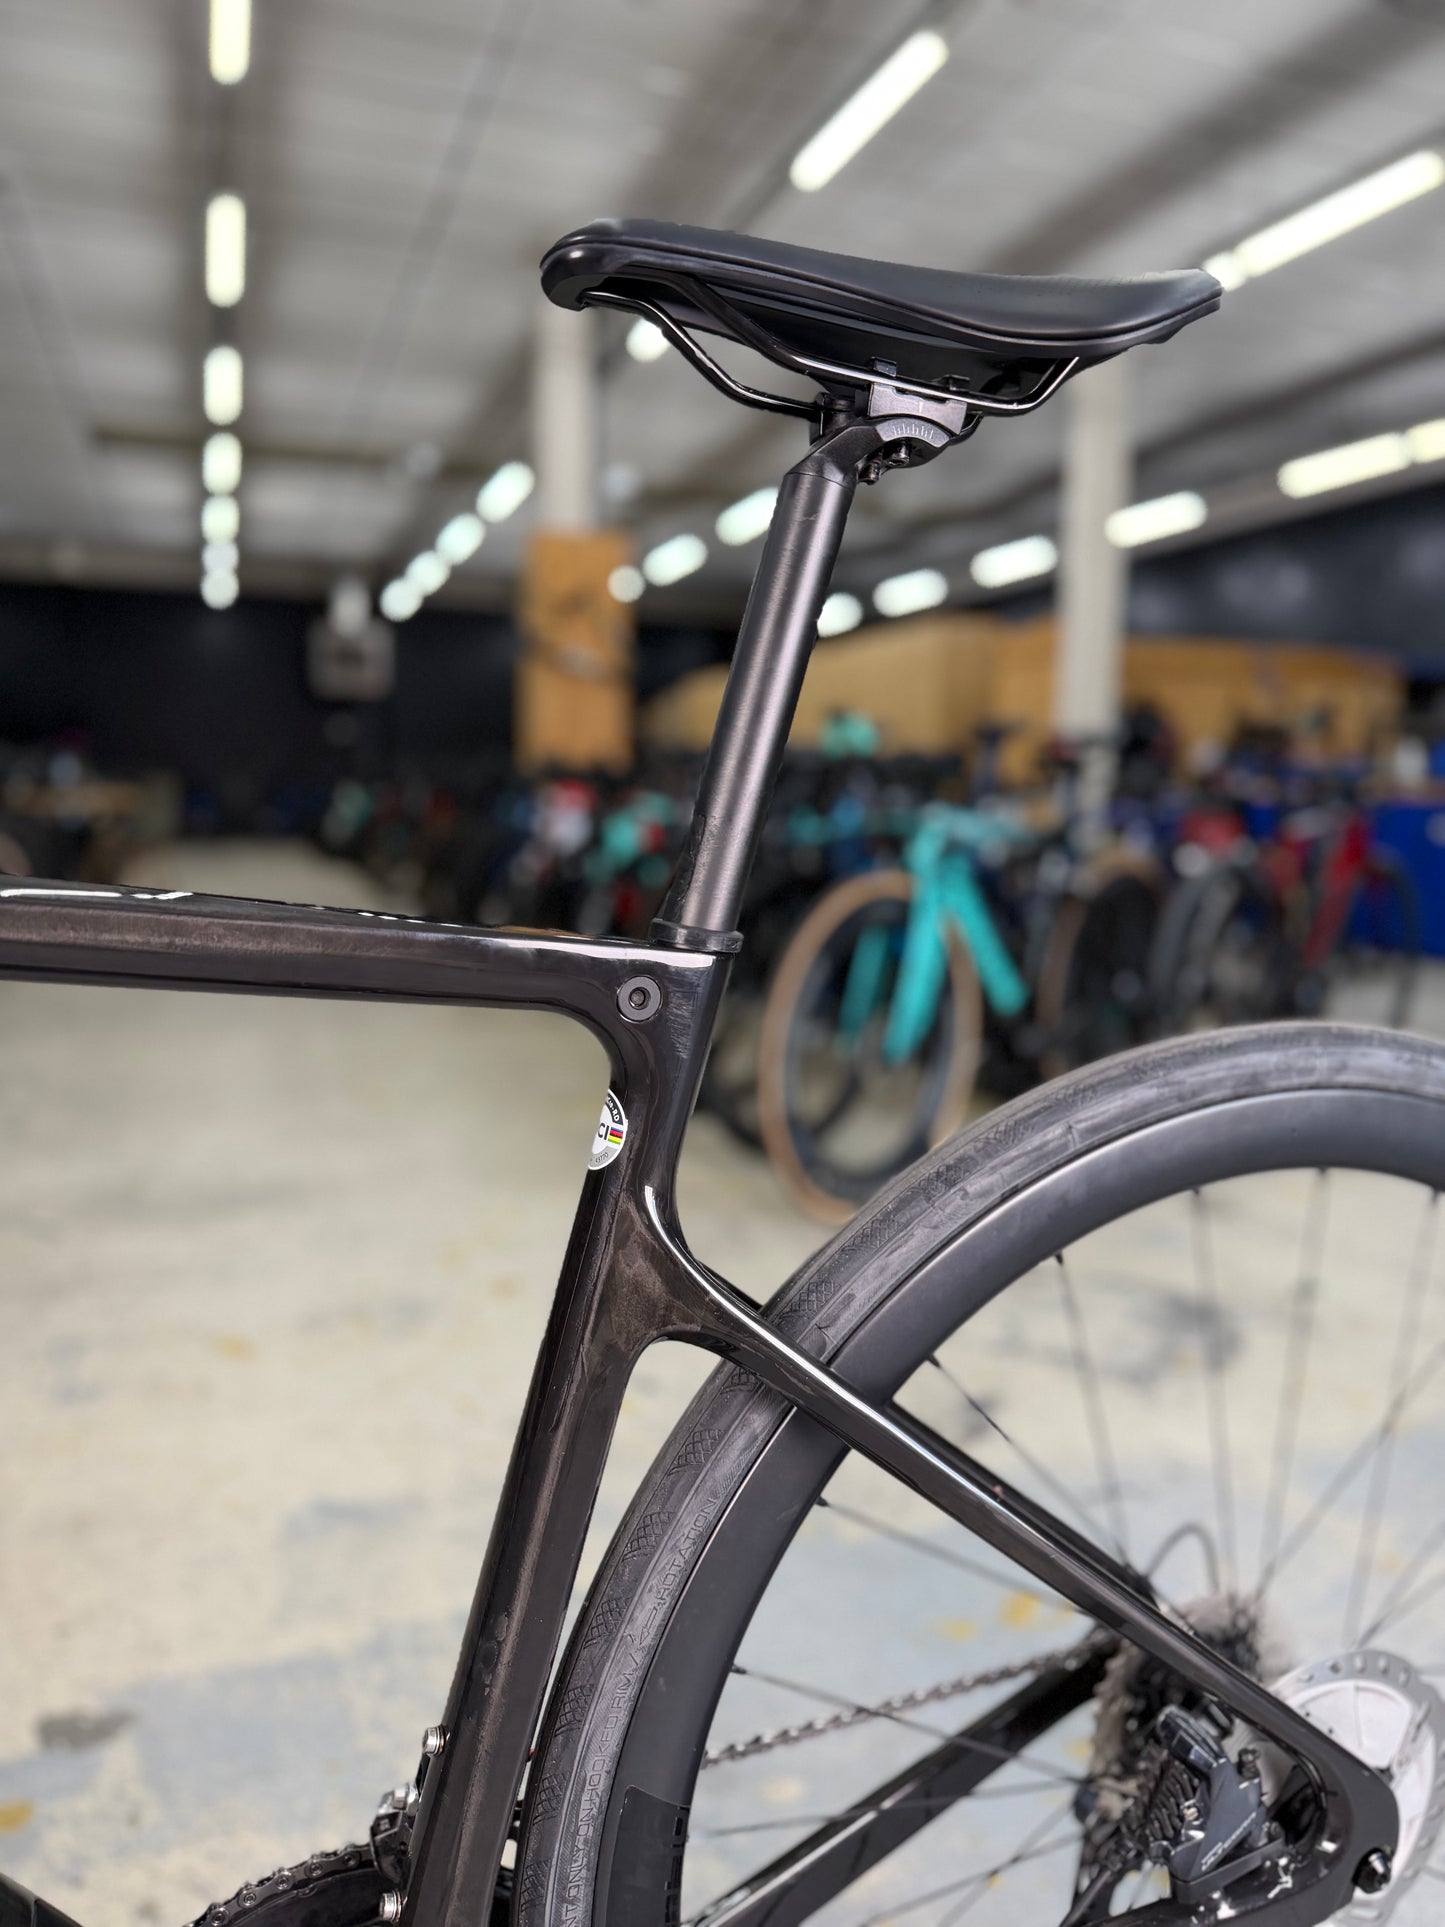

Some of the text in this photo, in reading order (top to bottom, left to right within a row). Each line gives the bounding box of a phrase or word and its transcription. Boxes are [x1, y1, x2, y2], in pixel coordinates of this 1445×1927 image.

[598, 1122, 609, 1140] CI
[656, 1497, 718, 1601] ROTATION
[611, 1671, 634, 1709] RIM
[583, 1715, 619, 1803] HOOKED
[577, 1808, 595, 1837] ON
[567, 1841, 585, 1898] ONLY
